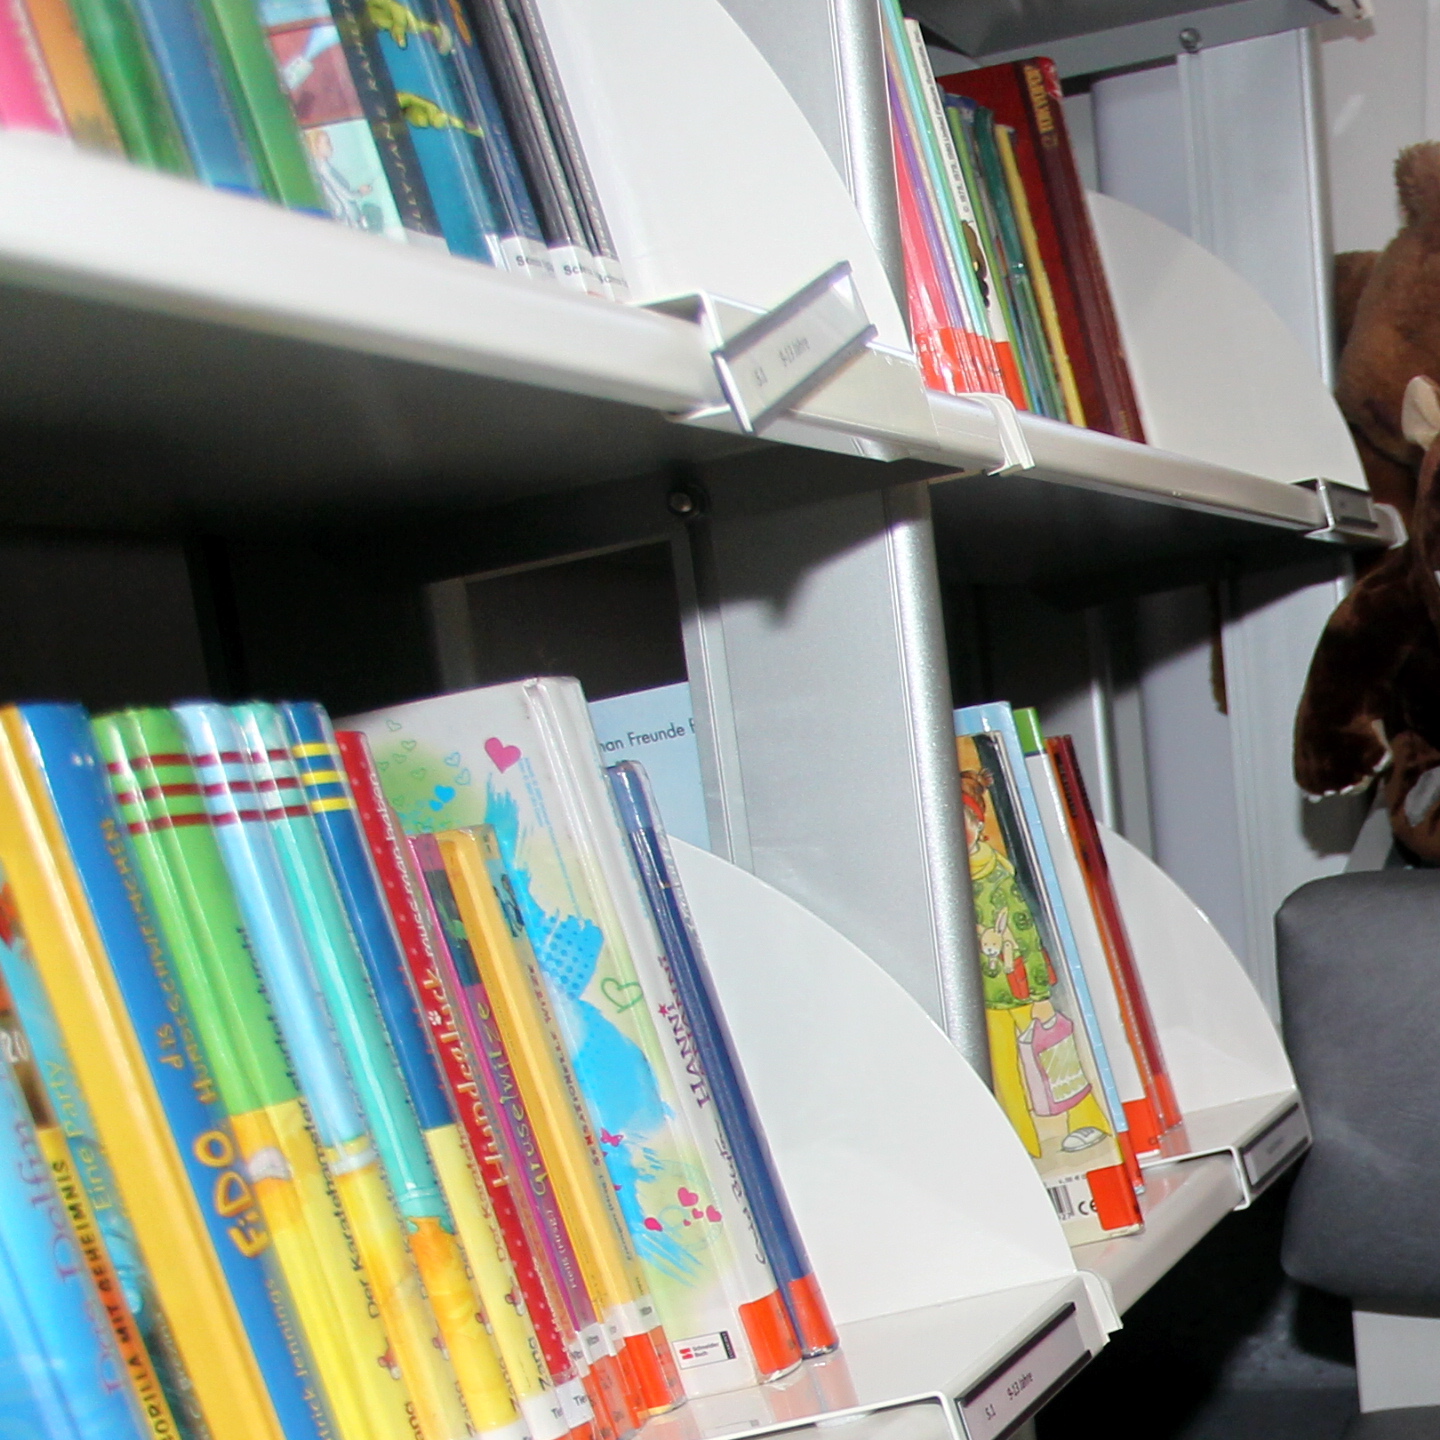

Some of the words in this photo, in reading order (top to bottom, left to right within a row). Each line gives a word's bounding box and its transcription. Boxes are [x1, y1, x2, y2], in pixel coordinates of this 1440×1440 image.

[927, 86, 943, 116] Feature
[935, 115, 951, 142] United
[627, 725, 686, 748] Freunde
[361, 769, 401, 845] haben
[389, 846, 417, 898] man
[405, 897, 437, 959] muss
[38, 1055, 90, 1139] Party
[412, 963, 515, 1189] Hundeglück
[468, 997, 553, 1200] Gruselwitze
[71, 1146, 115, 1214] Eine
[292, 1092, 366, 1275] Karatehamster
[48, 1156, 119, 1294] GEHEIMNIS
[105, 1299, 134, 1344] MIT
[261, 1275, 311, 1379] Jennings
[354, 1273, 383, 1321] Der
[524, 1334, 553, 1391] Zang
[985, 1403, 996, 1420] 5.1
[1007, 1381, 1020, 1400] 9-13
